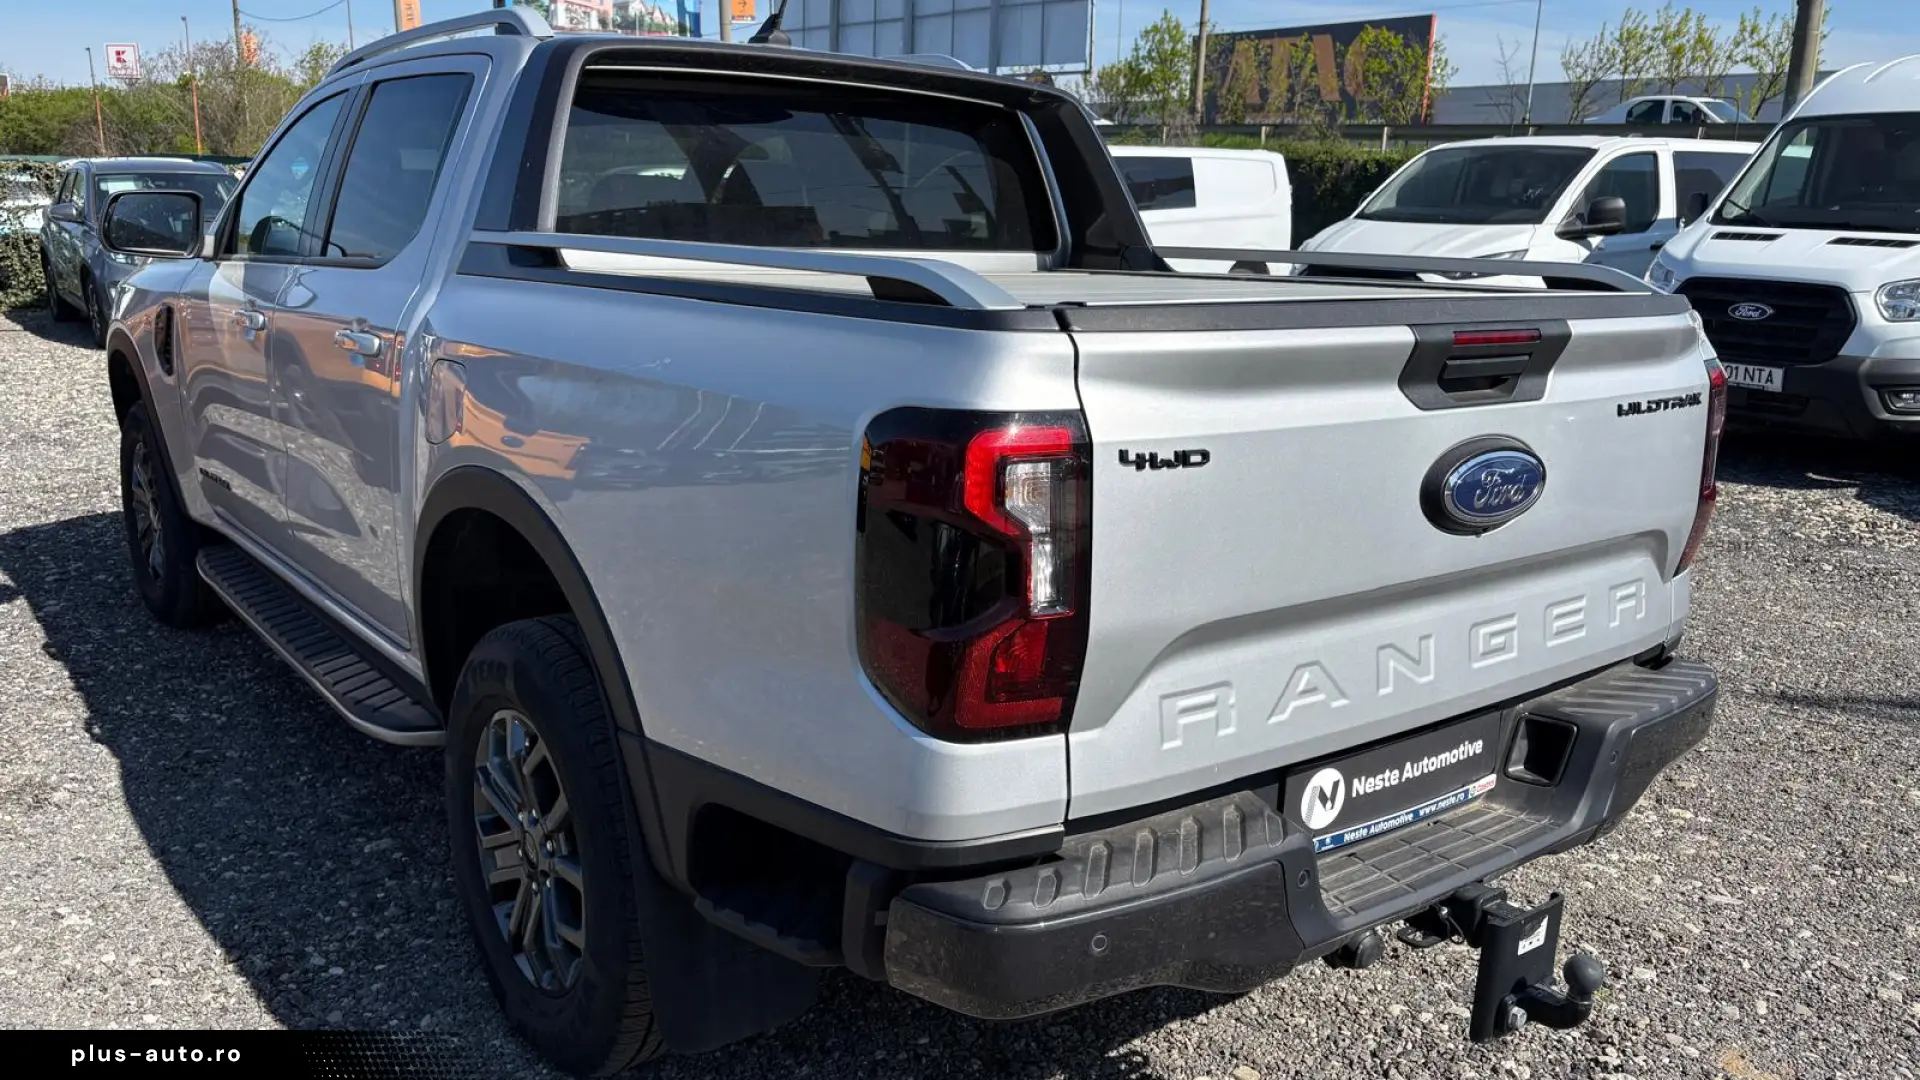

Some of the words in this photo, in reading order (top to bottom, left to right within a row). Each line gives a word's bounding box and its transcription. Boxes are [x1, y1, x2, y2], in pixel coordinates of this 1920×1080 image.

[1743, 366, 1774, 385] NTA
[1617, 393, 1703, 417] WILDTRAK
[1118, 449, 1211, 472] 4WD
[1474, 468, 1526, 509] Ford
[1159, 578, 1646, 749] RANGER
[1352, 768, 1399, 797] Neste
[1401, 740, 1483, 782] Automotive
[1343, 828, 1368, 842] Neste
[1369, 813, 1414, 834] Automotive
[1419, 792, 1465, 816] www.neste.ro
